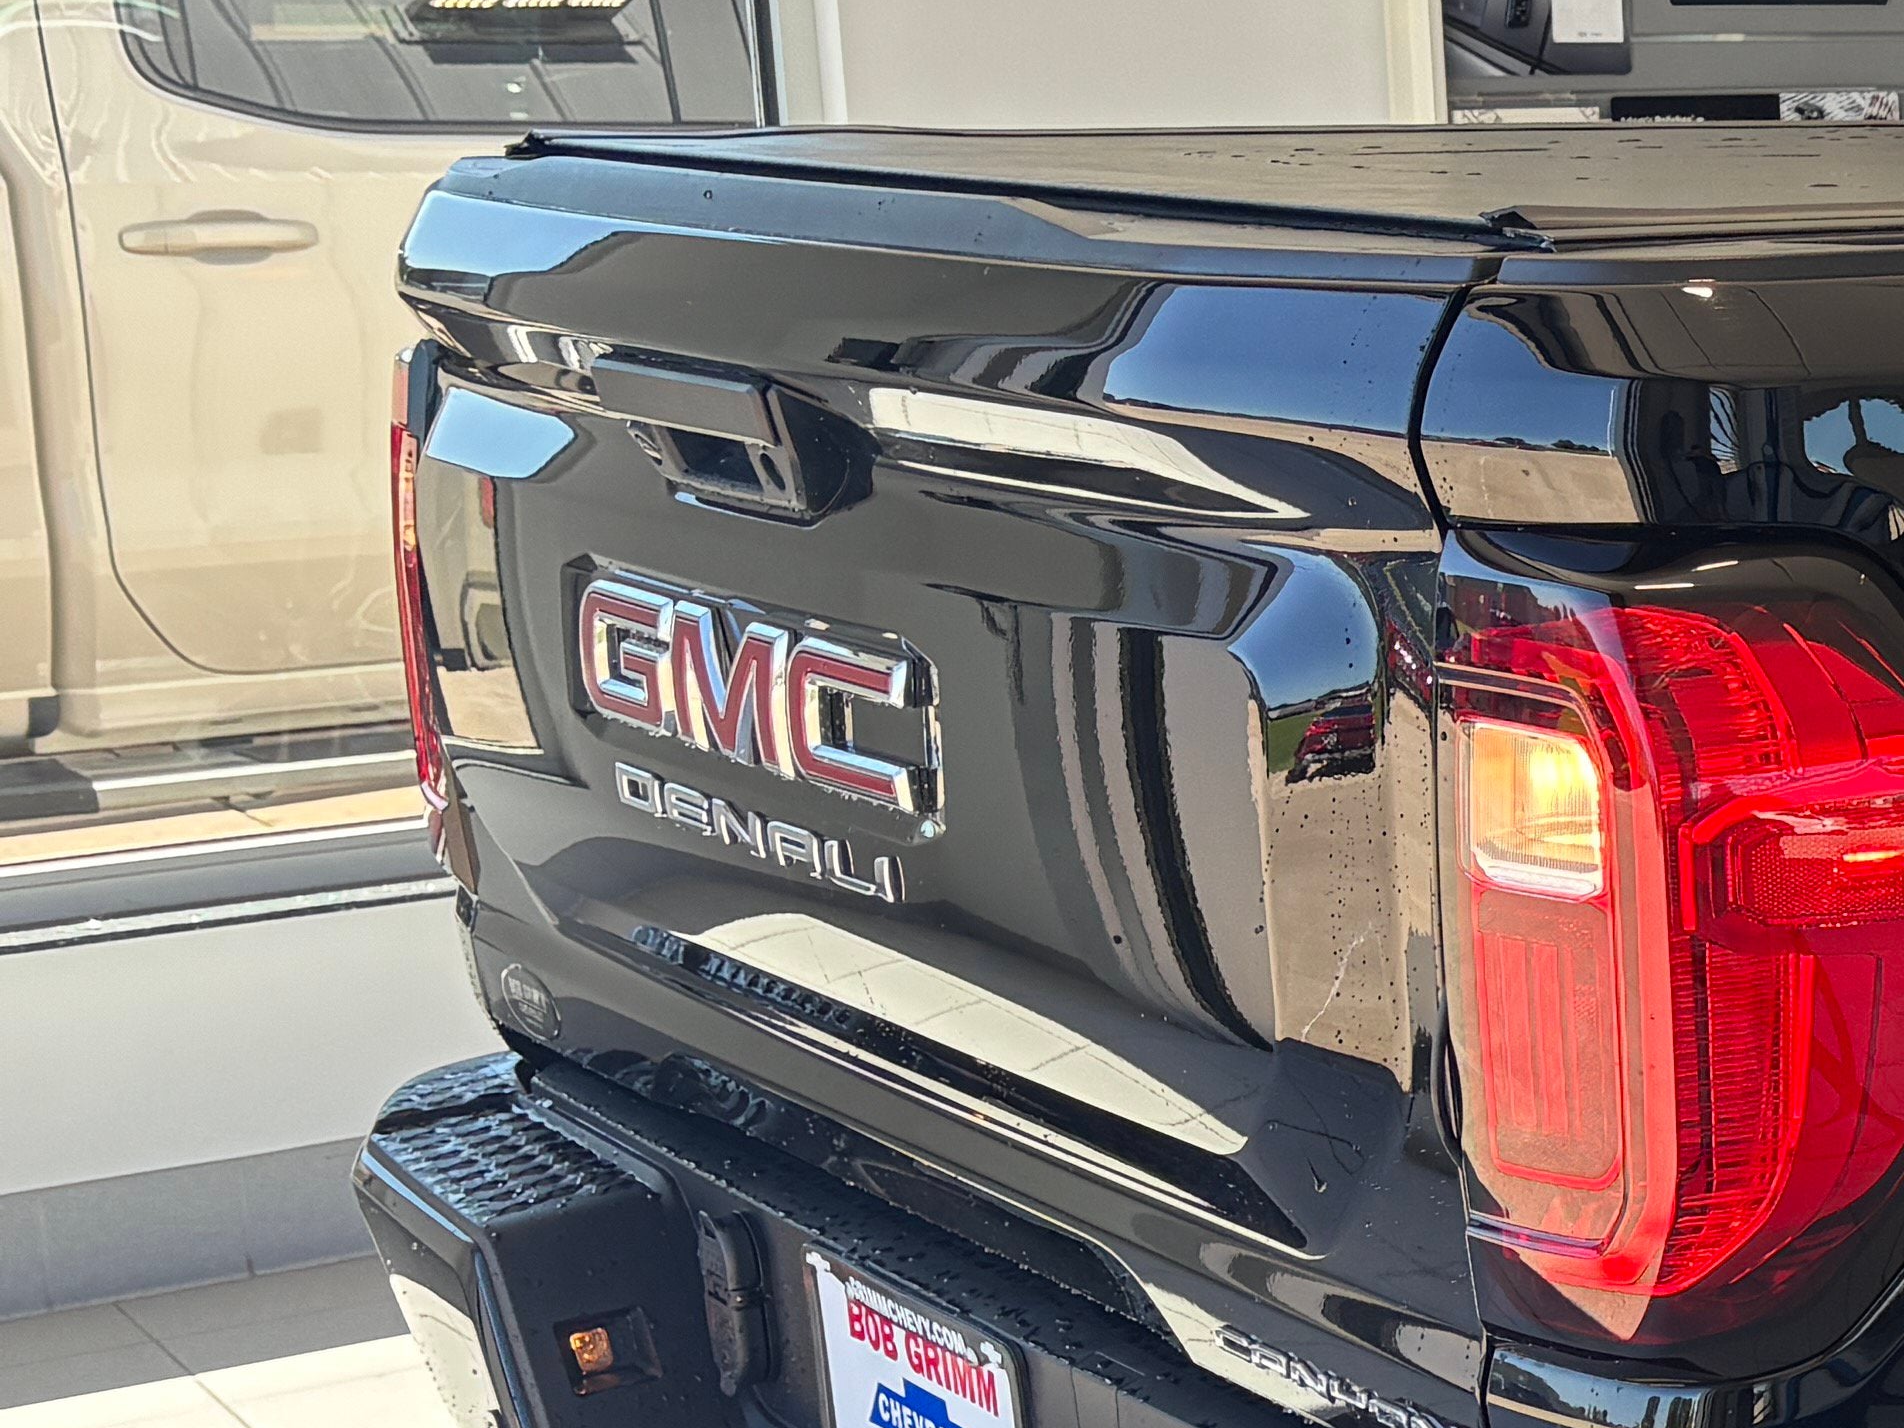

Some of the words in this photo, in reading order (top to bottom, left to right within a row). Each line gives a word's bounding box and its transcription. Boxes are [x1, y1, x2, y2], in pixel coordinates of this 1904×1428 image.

[579, 579, 916, 814] GMC
[615, 762, 905, 903] DENALI
[848, 1299, 898, 1361] BOB
[905, 1330, 999, 1418] GRIMM
